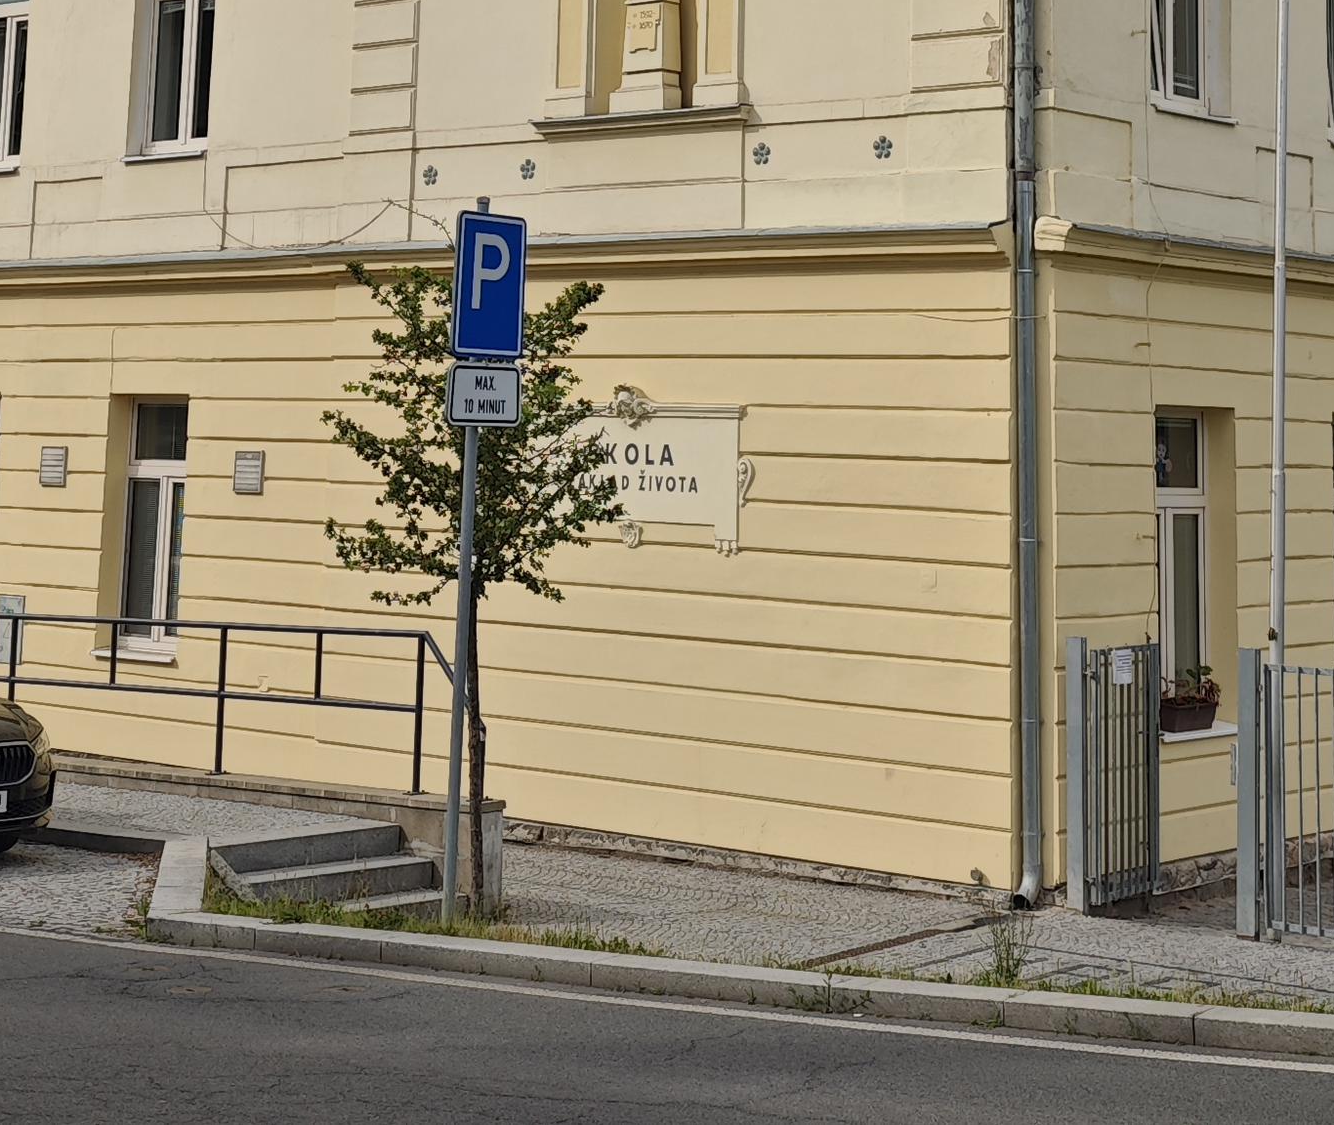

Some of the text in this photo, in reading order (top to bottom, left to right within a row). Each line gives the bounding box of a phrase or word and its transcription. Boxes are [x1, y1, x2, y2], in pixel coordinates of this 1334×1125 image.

[471, 232, 511, 310] P
[474, 375, 497, 391] MAX.
[464, 398, 507, 415] 10 MINUT
[586, 441, 674, 466] KOLA
[638, 469, 698, 493] ŽIVOTA
